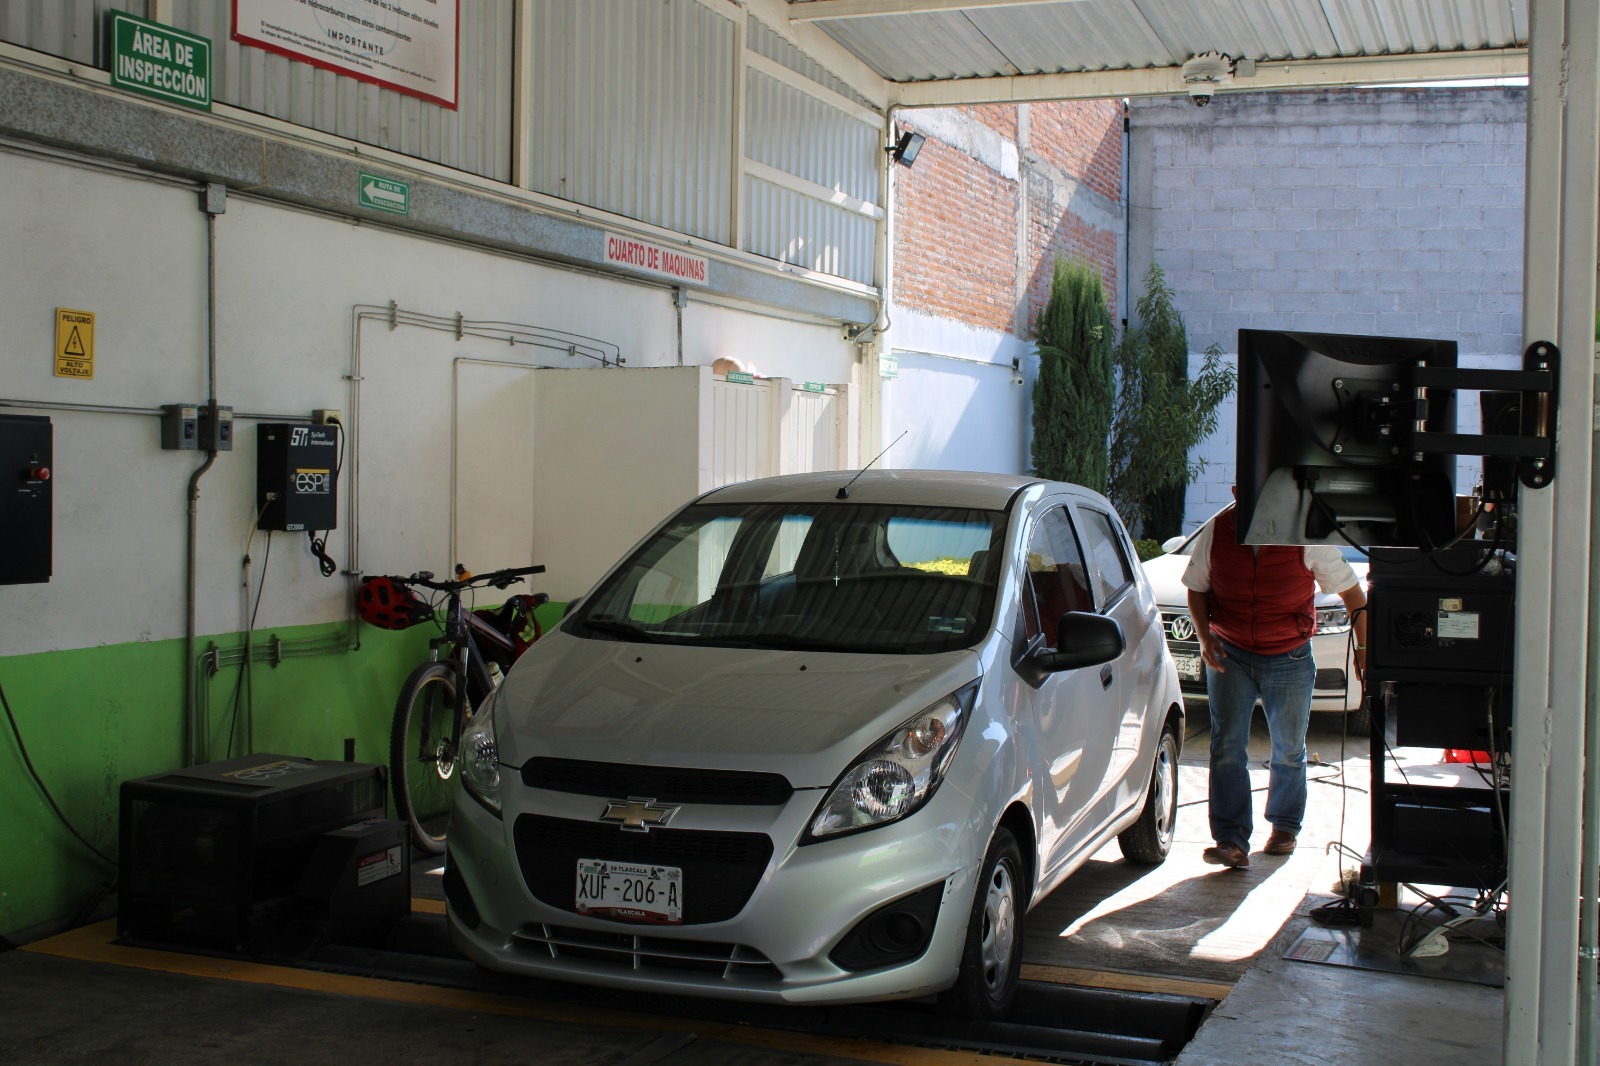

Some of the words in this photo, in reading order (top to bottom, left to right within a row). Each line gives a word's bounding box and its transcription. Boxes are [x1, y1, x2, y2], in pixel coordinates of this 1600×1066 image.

[328, 28, 384, 55] IMPORTANTE
[346, 14, 360, 24] entre
[362, 19, 374, 28] otros
[376, 24, 412, 42] contaminantes
[132, 26, 172, 62] ÁREA
[176, 42, 193, 68] DE
[120, 54, 205, 98] INSPECCIÓN
[378, 182, 392, 190] RUTA
[608, 237, 644, 266] CUARTO
[648, 247, 659, 270] DE
[662, 251, 705, 281] MAQUINAS
[62, 314, 91, 324] PELIGRO
[365, 852, 387, 863] DANGER
[579, 874, 677, 907] XUF-206-A
